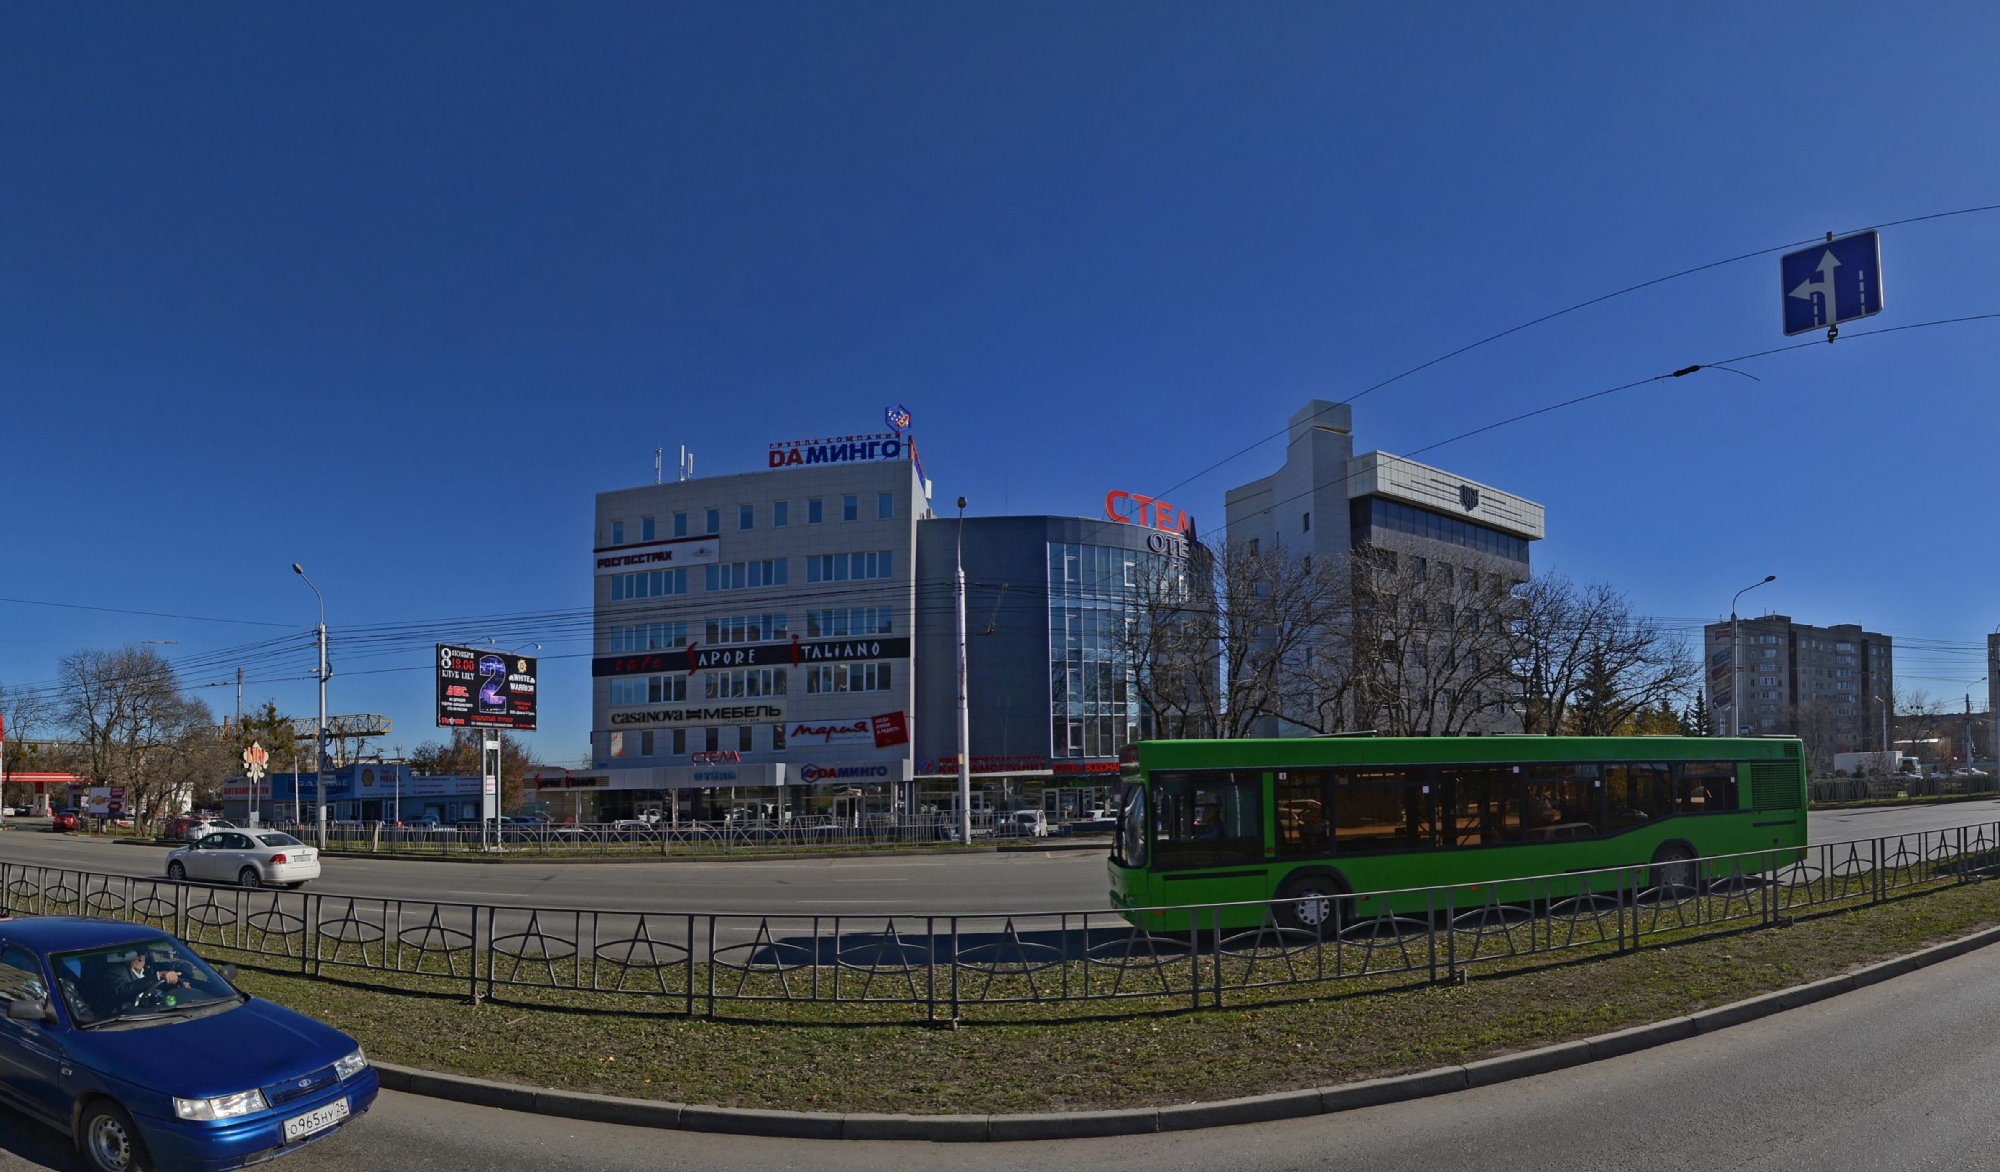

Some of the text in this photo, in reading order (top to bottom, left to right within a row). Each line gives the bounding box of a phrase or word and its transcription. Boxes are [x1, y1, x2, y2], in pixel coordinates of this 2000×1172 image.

[770, 439, 820, 450] ГРУППА
[1106, 490, 1197, 540] СТЕЛ
[597, 550, 672, 569] РОСГОССТРАХ
[441, 648, 452, 668] 8
[452, 650, 474, 658] НОЯБРЯ
[614, 655, 662, 672] cafe
[442, 670, 475, 680] КЛУБ LILY
[513, 674, 530, 682] WHITE
[479, 655, 506, 714] 2
[510, 683, 534, 692] WARRIOR
[704, 706, 781, 720] МЕБЕЛЬ
[247, 746, 266, 765] LILY
[692, 750, 741, 764] СТЕЛА
[694, 770, 736, 781] ОТЕЛЬ
[336, 1101, 345, 1113] 26
